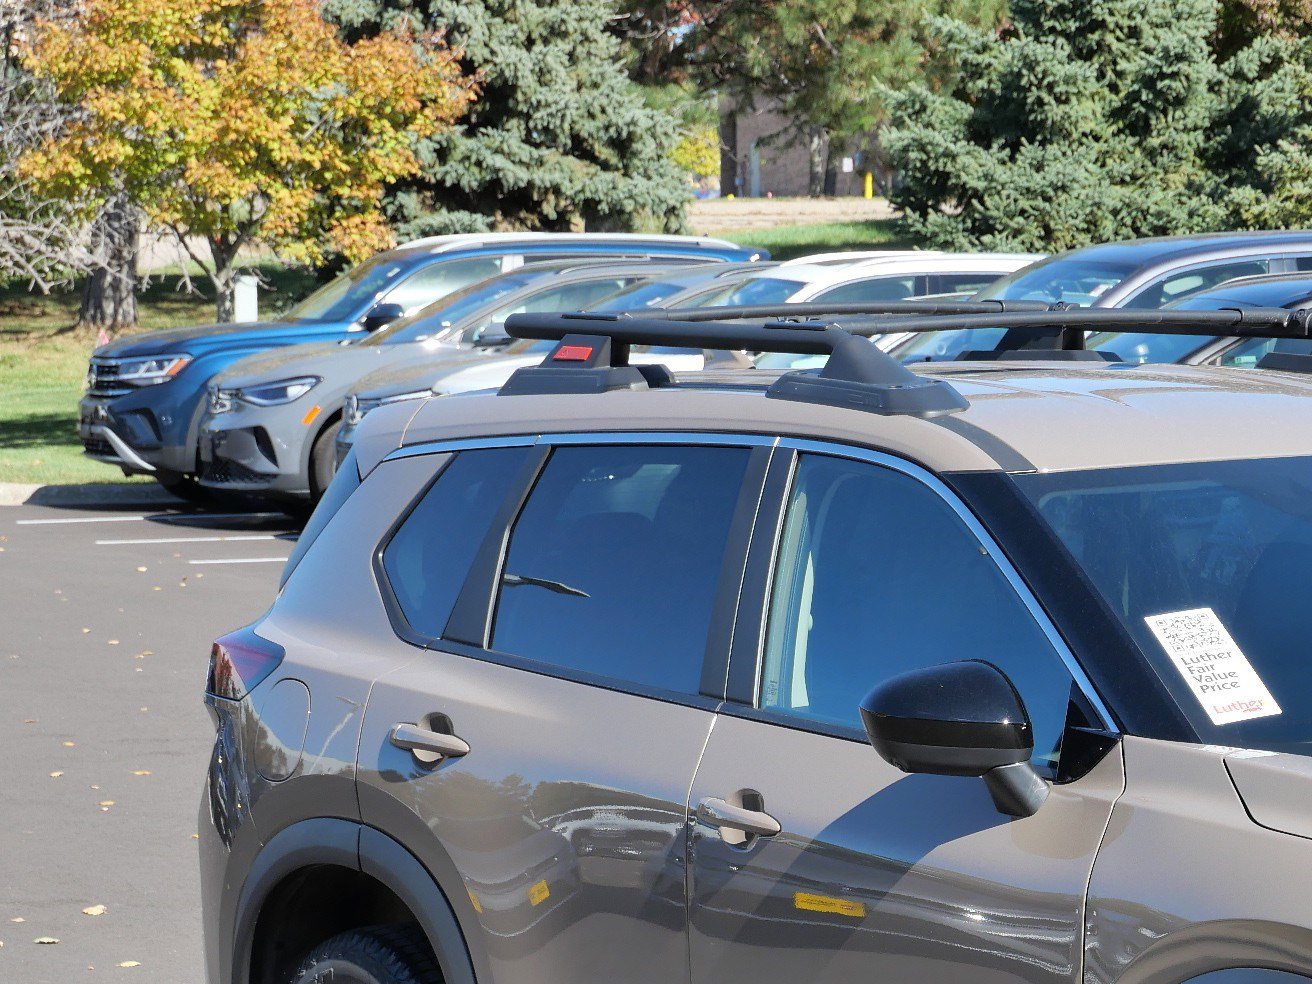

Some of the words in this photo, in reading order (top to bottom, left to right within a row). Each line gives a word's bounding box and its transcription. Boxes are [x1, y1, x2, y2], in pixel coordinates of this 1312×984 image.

[1181, 651, 1232, 666] Luther
[1187, 663, 1216, 675] Fair
[1194, 670, 1239, 683] Value
[1199, 680, 1241, 694] Price
[1212, 699, 1264, 715] Luther
